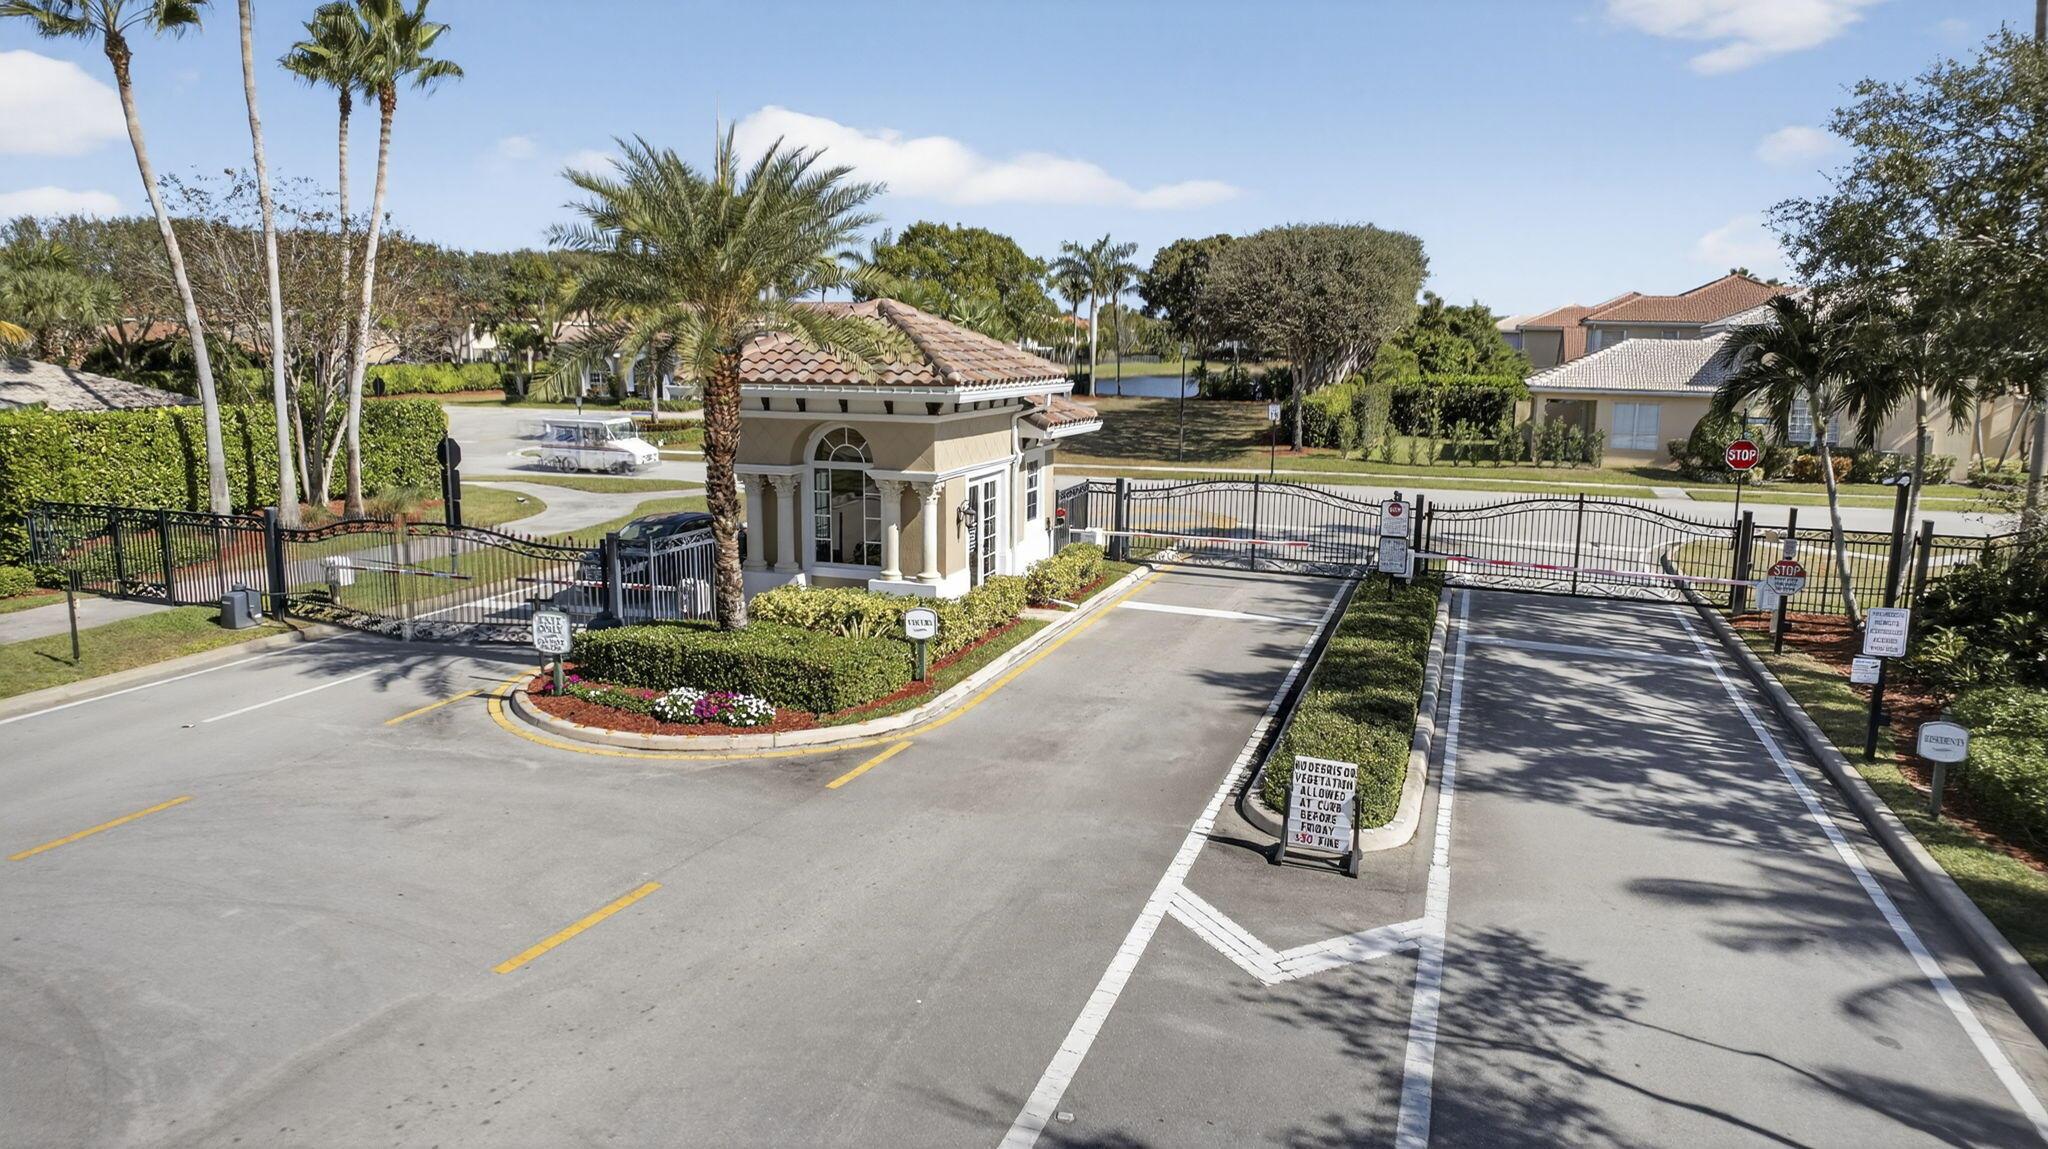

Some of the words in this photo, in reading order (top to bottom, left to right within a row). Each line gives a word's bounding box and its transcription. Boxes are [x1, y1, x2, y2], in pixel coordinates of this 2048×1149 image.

[1728, 449, 1757, 461] STOP
[1773, 564, 1801, 576] STOP
[1295, 760, 1307, 771] NO
[1300, 785, 1346, 801] ALLOWED
[1300, 797, 1312, 808] AT
[1317, 800, 1342, 813] CURB
[1300, 809, 1337, 825] BEFORE
[1300, 821, 1335, 836] FRIDAY
[1317, 836, 1340, 849] FINE
